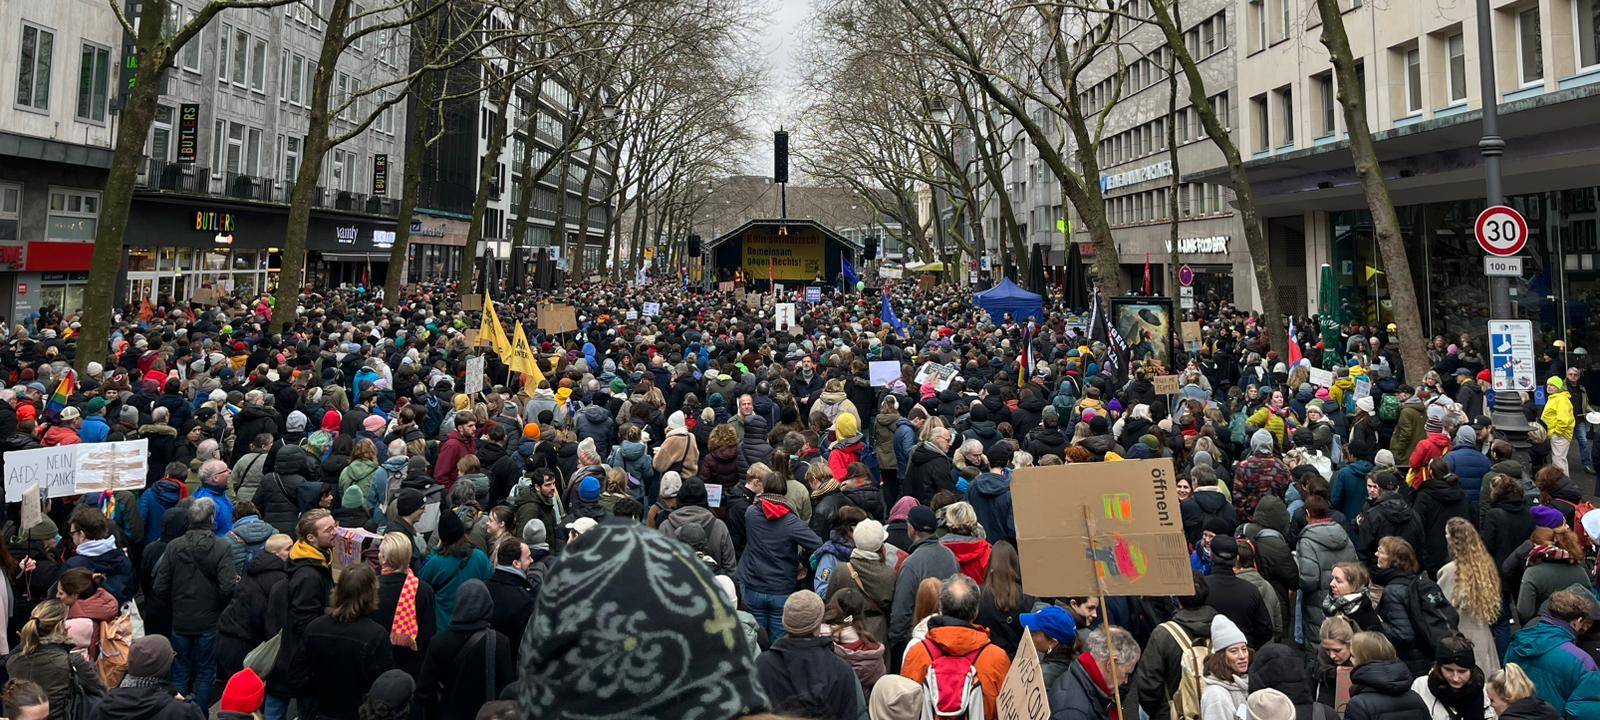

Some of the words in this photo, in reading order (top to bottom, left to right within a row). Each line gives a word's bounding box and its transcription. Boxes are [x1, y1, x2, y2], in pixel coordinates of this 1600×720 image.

[181, 107, 196, 154] BUTLERS
[196, 211, 237, 231] BUTLERS
[1487, 221, 1516, 241] 30
[747, 247, 792, 256] Gemeinsam
[1490, 263, 1506, 272] 100
[46, 453, 73, 471] NEIN
[46, 470, 76, 488] DANKE
[1151, 468, 1175, 526] öffnen!
